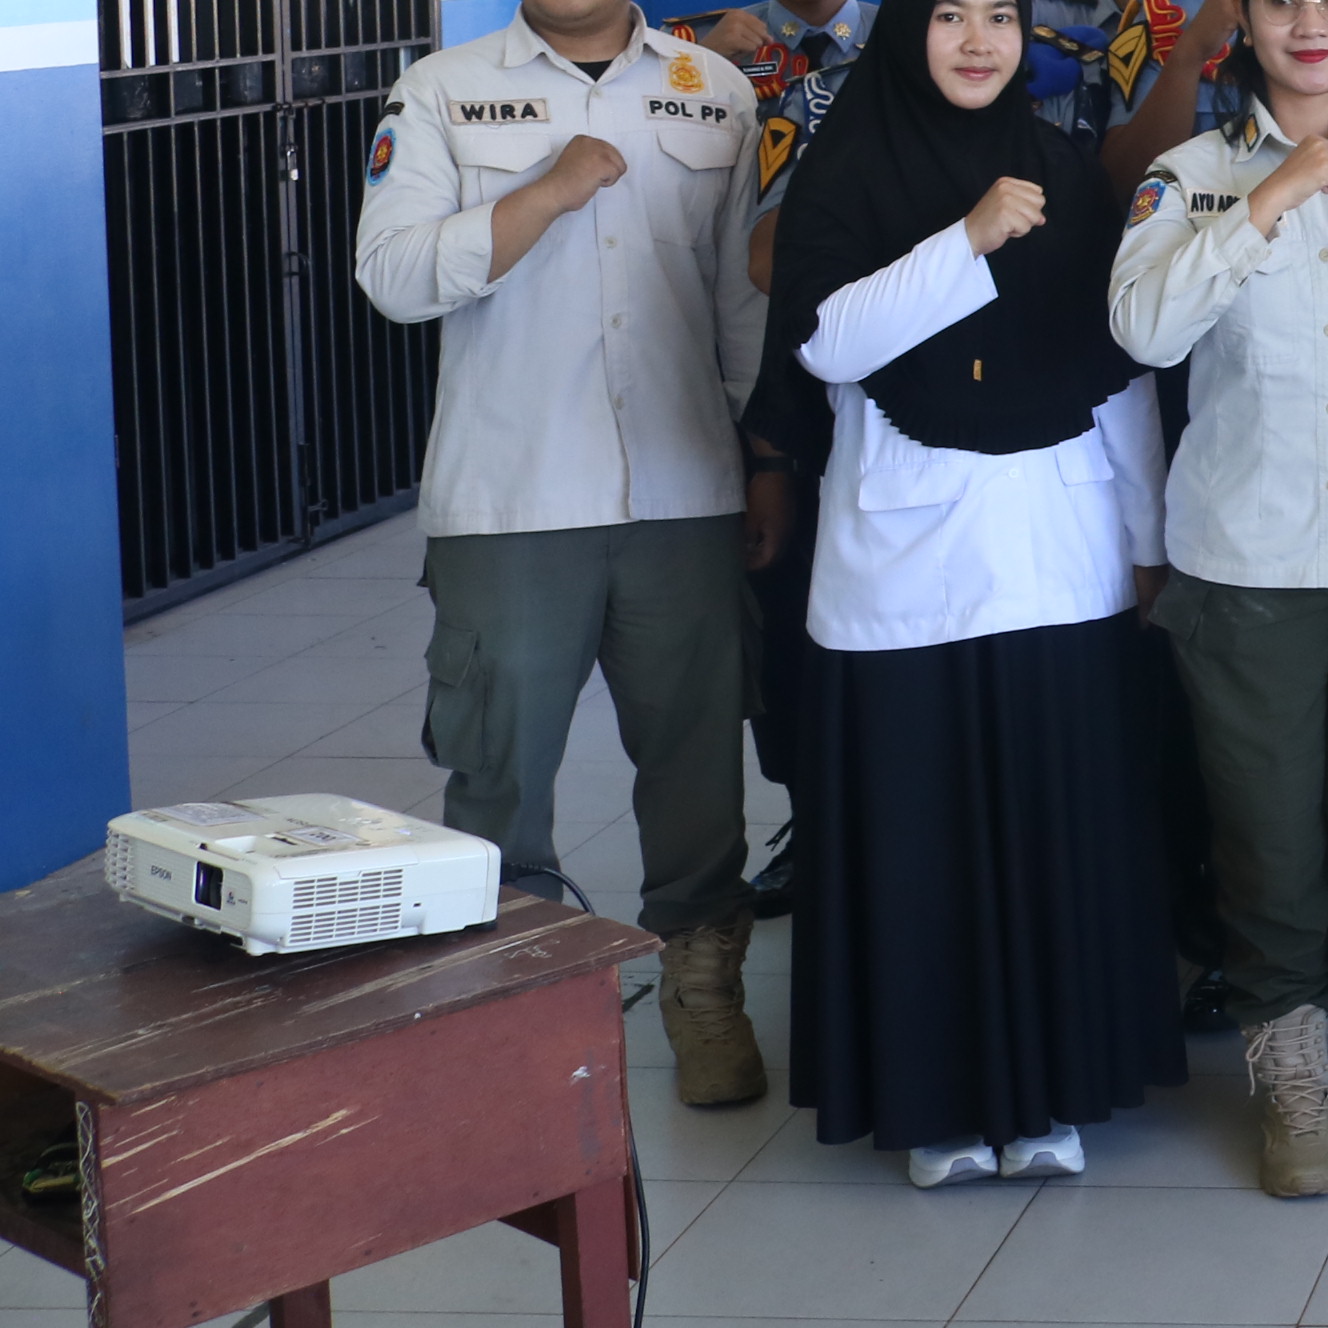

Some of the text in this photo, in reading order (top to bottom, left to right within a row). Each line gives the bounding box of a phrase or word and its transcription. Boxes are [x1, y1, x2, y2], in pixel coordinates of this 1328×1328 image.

[460, 103, 538, 122] WIRA
[650, 100, 728, 123] POL PP
[1191, 193, 1214, 212] AYU
